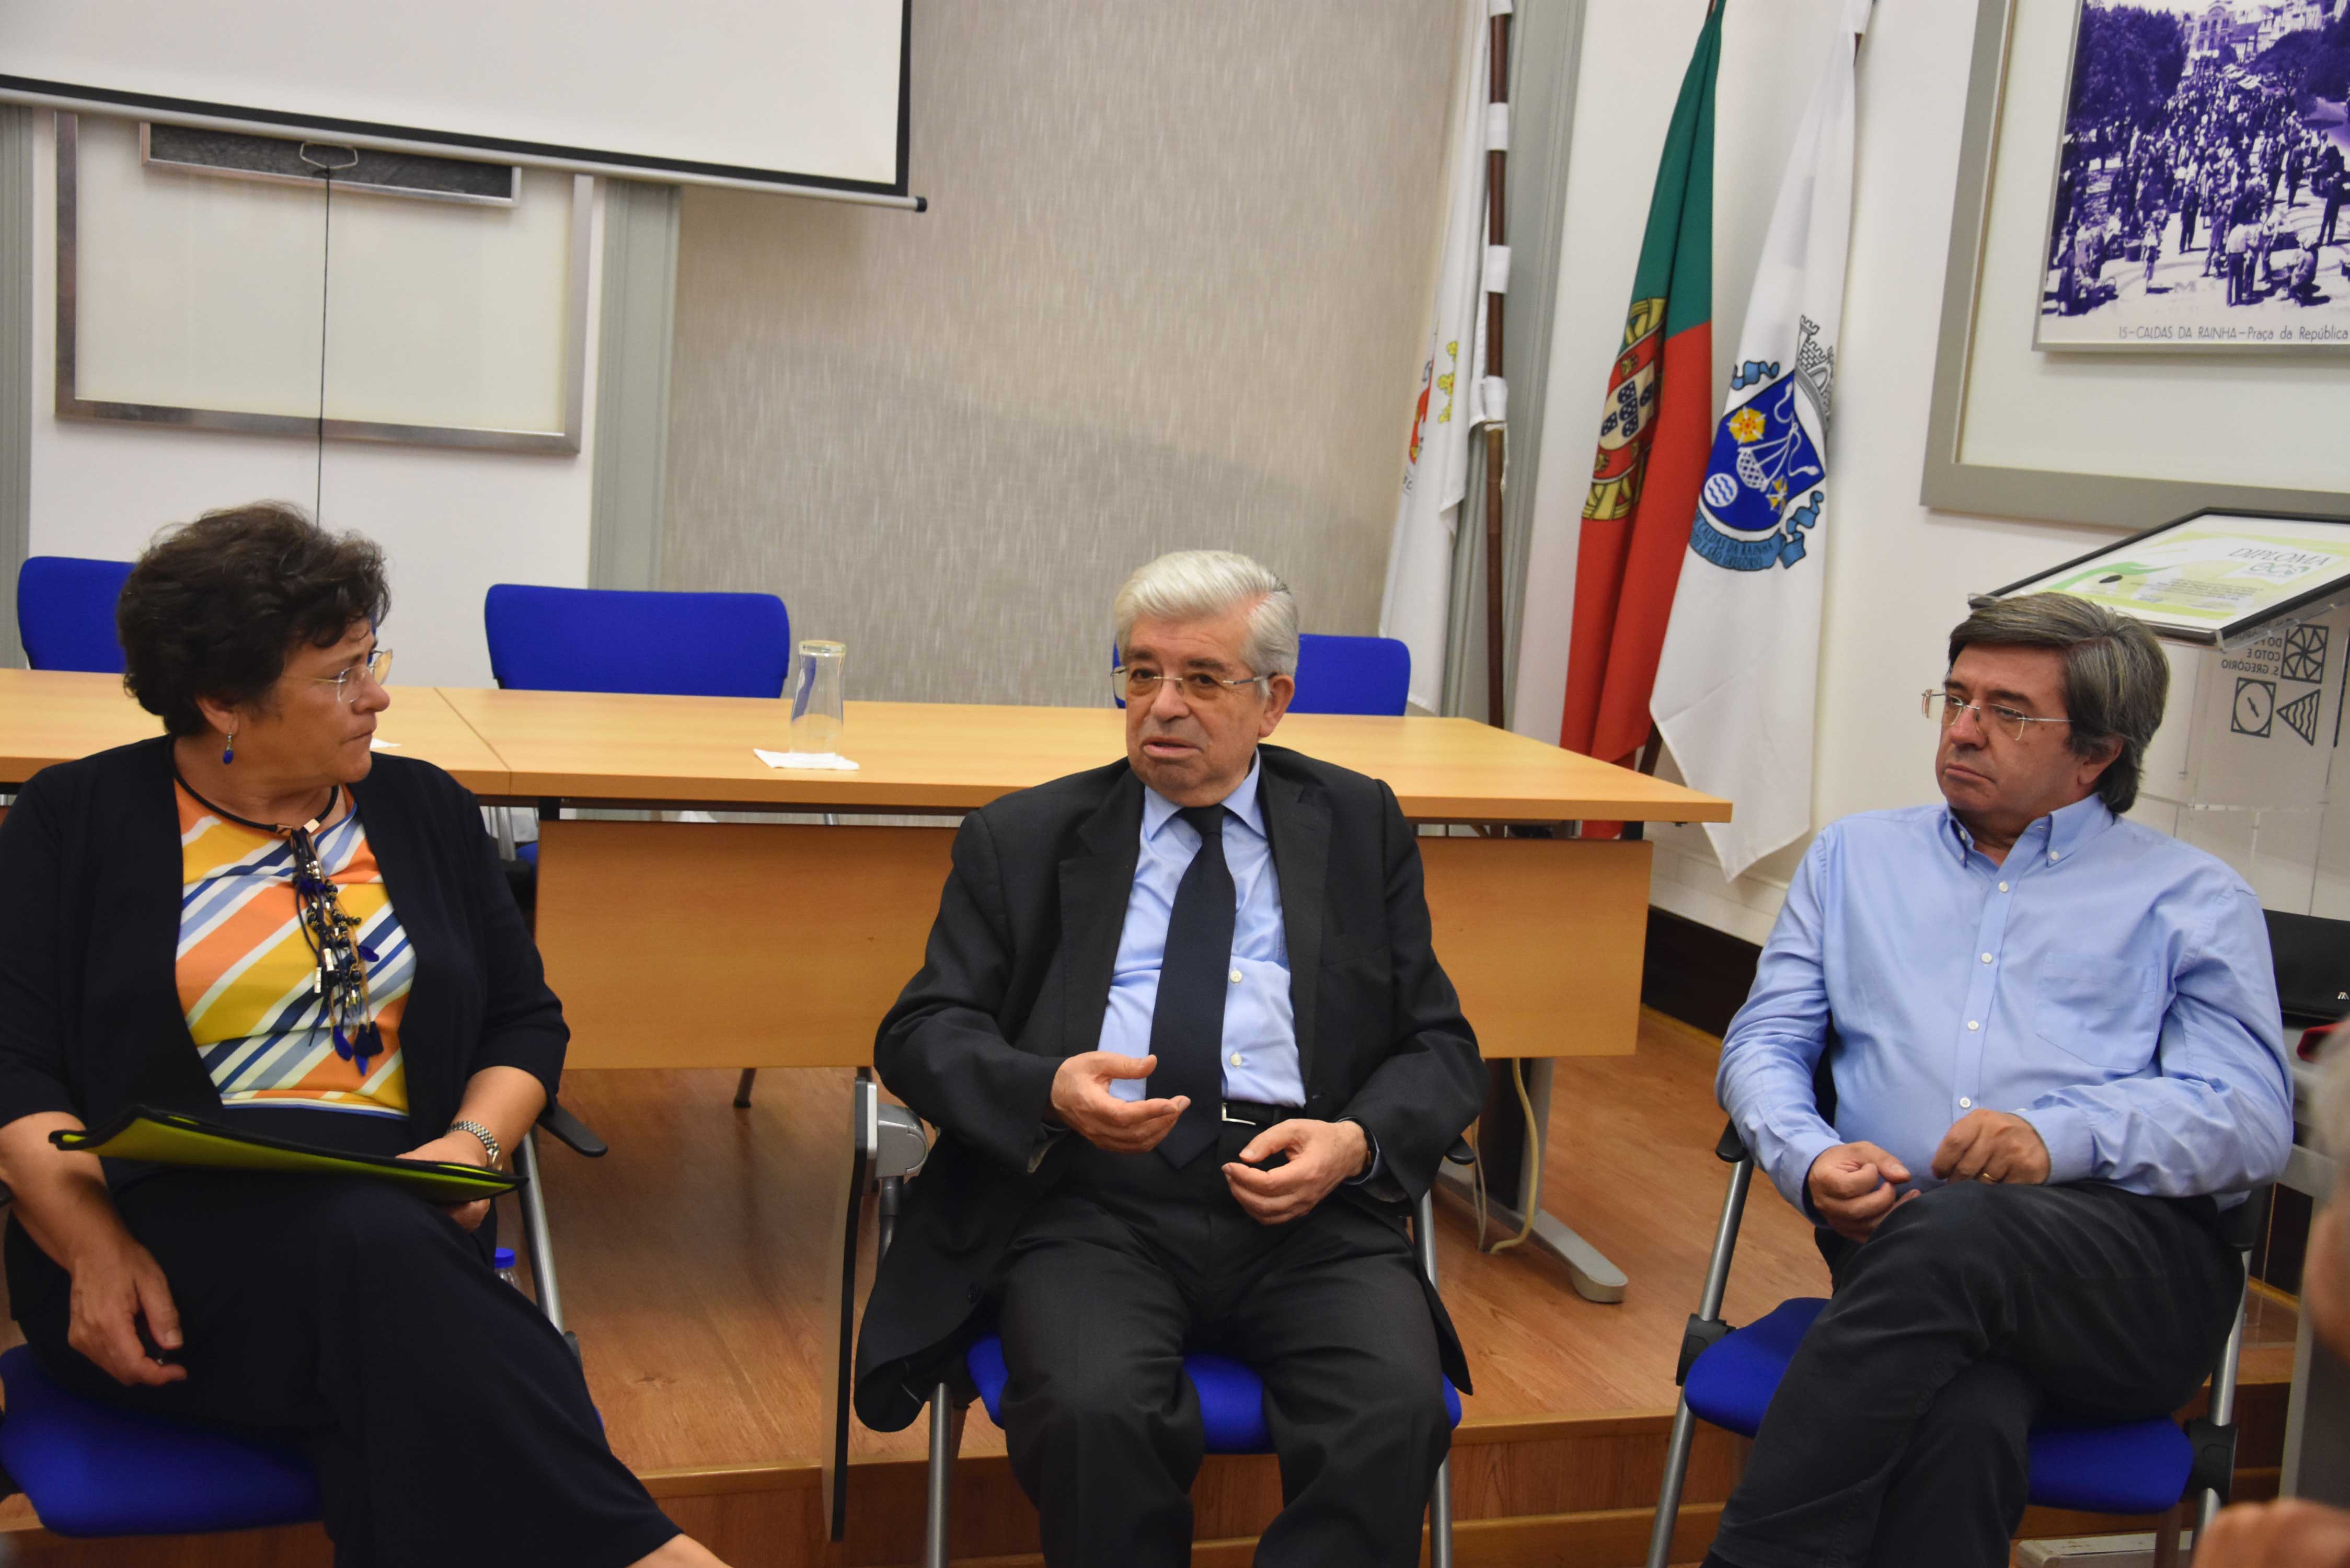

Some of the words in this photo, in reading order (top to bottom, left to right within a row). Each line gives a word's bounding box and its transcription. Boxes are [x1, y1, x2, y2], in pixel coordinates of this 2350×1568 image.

[2178, 326, 2192, 339] DA
[2280, 325, 2293, 339] da
[2299, 324, 2349, 342] República
[1727, 541, 1738, 553] DA
[2227, 547, 2331, 566] DIPLOMA
